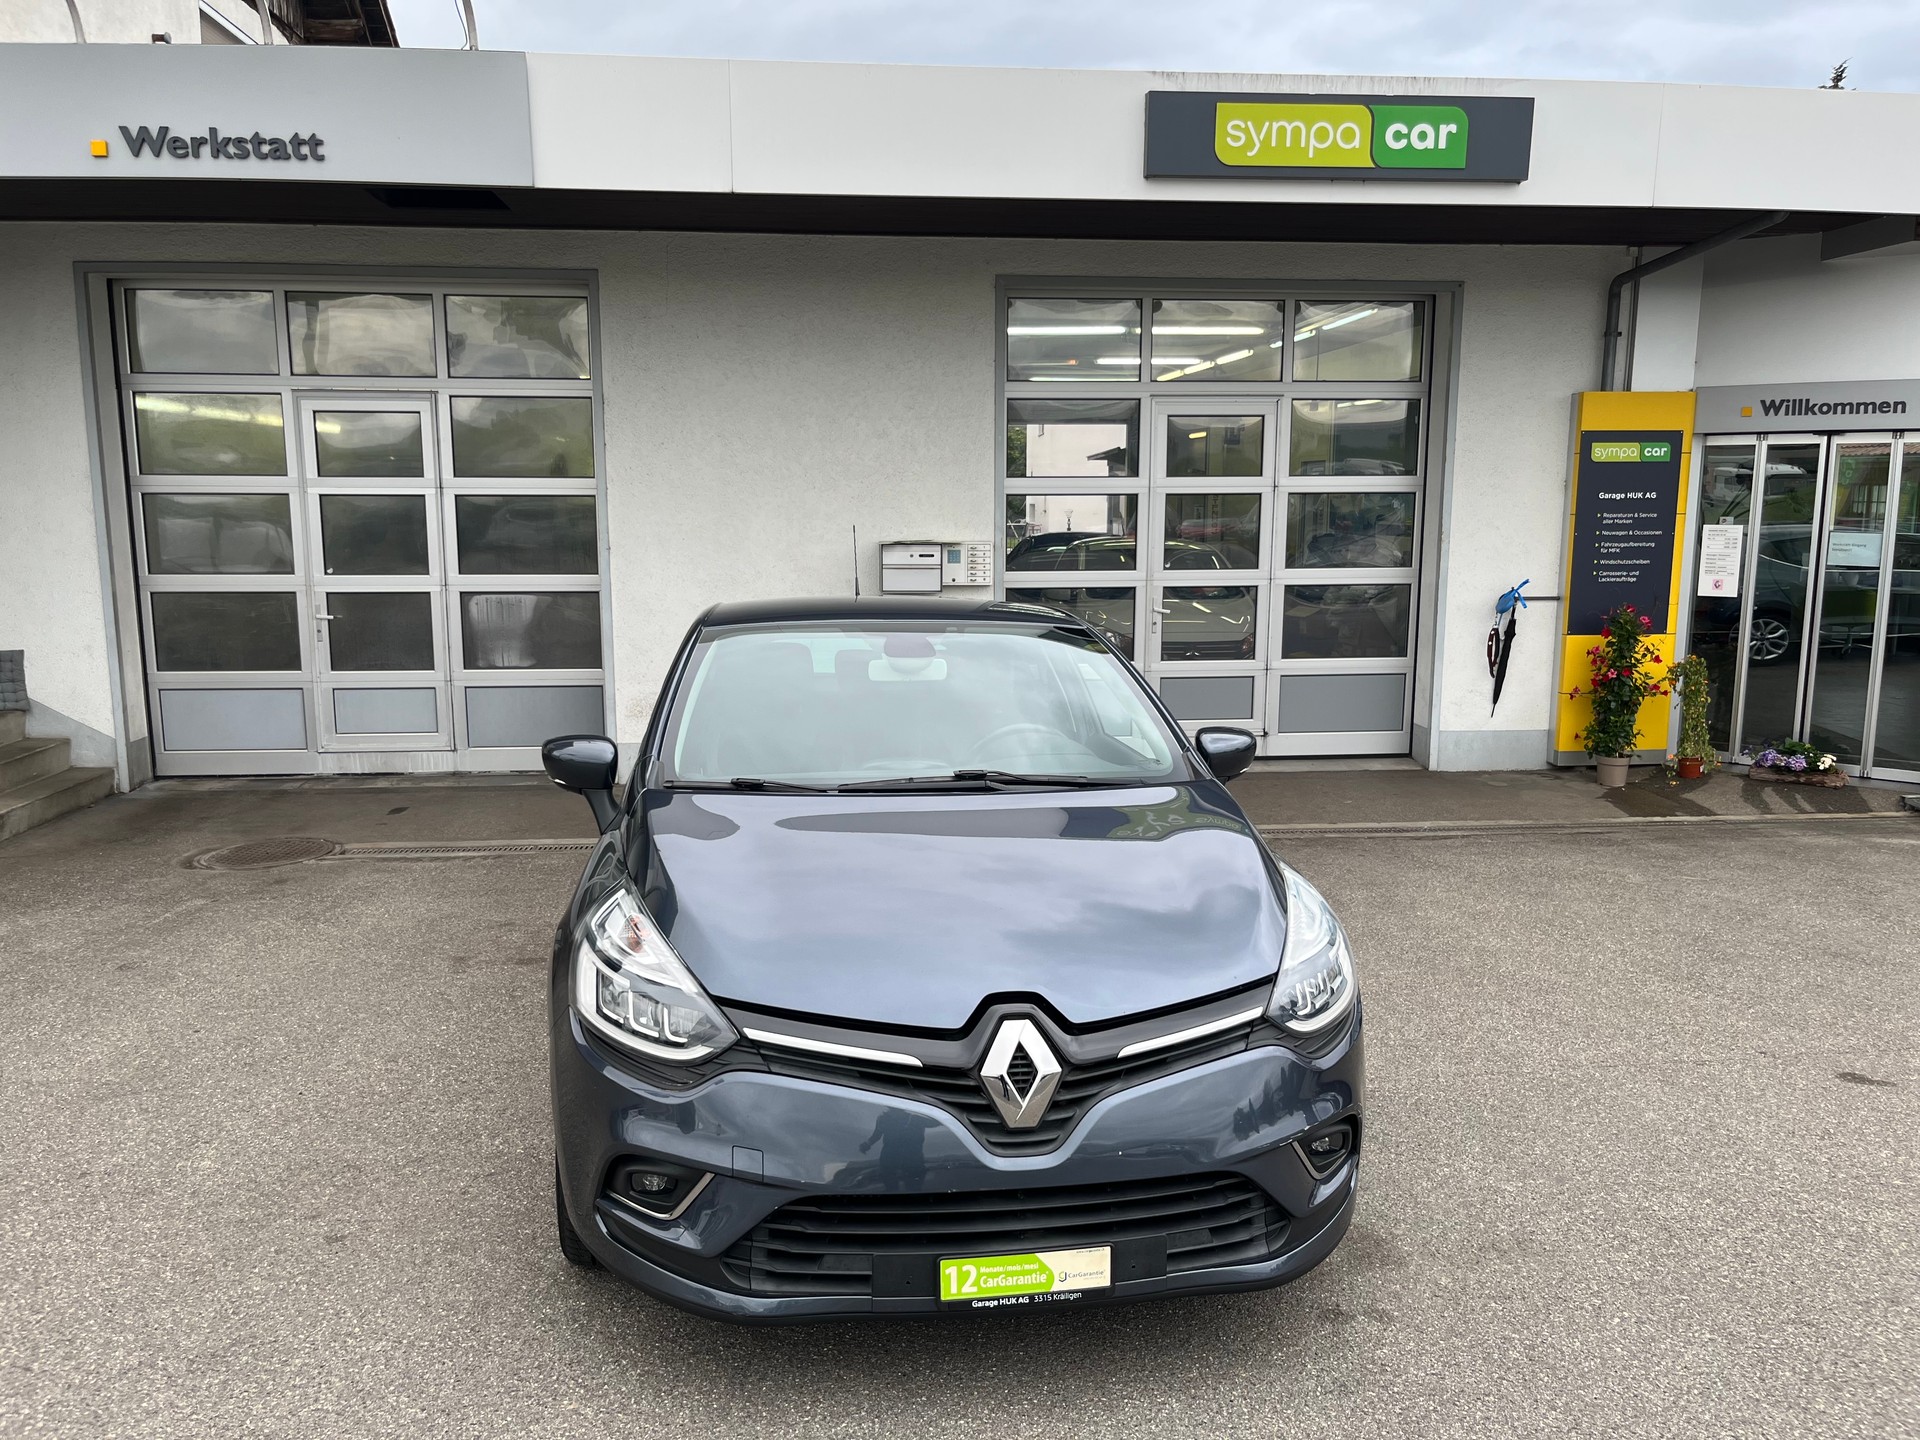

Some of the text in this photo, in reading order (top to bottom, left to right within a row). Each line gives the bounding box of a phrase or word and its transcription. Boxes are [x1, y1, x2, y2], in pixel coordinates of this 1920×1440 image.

[118, 125, 326, 161] Werkstatt
[1226, 119, 1457, 158] sympa car
[1760, 398, 1907, 417] Willkommen
[1594, 447, 1668, 459] sympa car
[1598, 492, 1625, 500] Garage
[945, 1264, 978, 1295] 12
[971, 1299, 999, 1308] Garage
[999, 1297, 1017, 1305] HUK
[1018, 1296, 1030, 1304] AG
[1033, 1294, 1053, 1303] 3315
